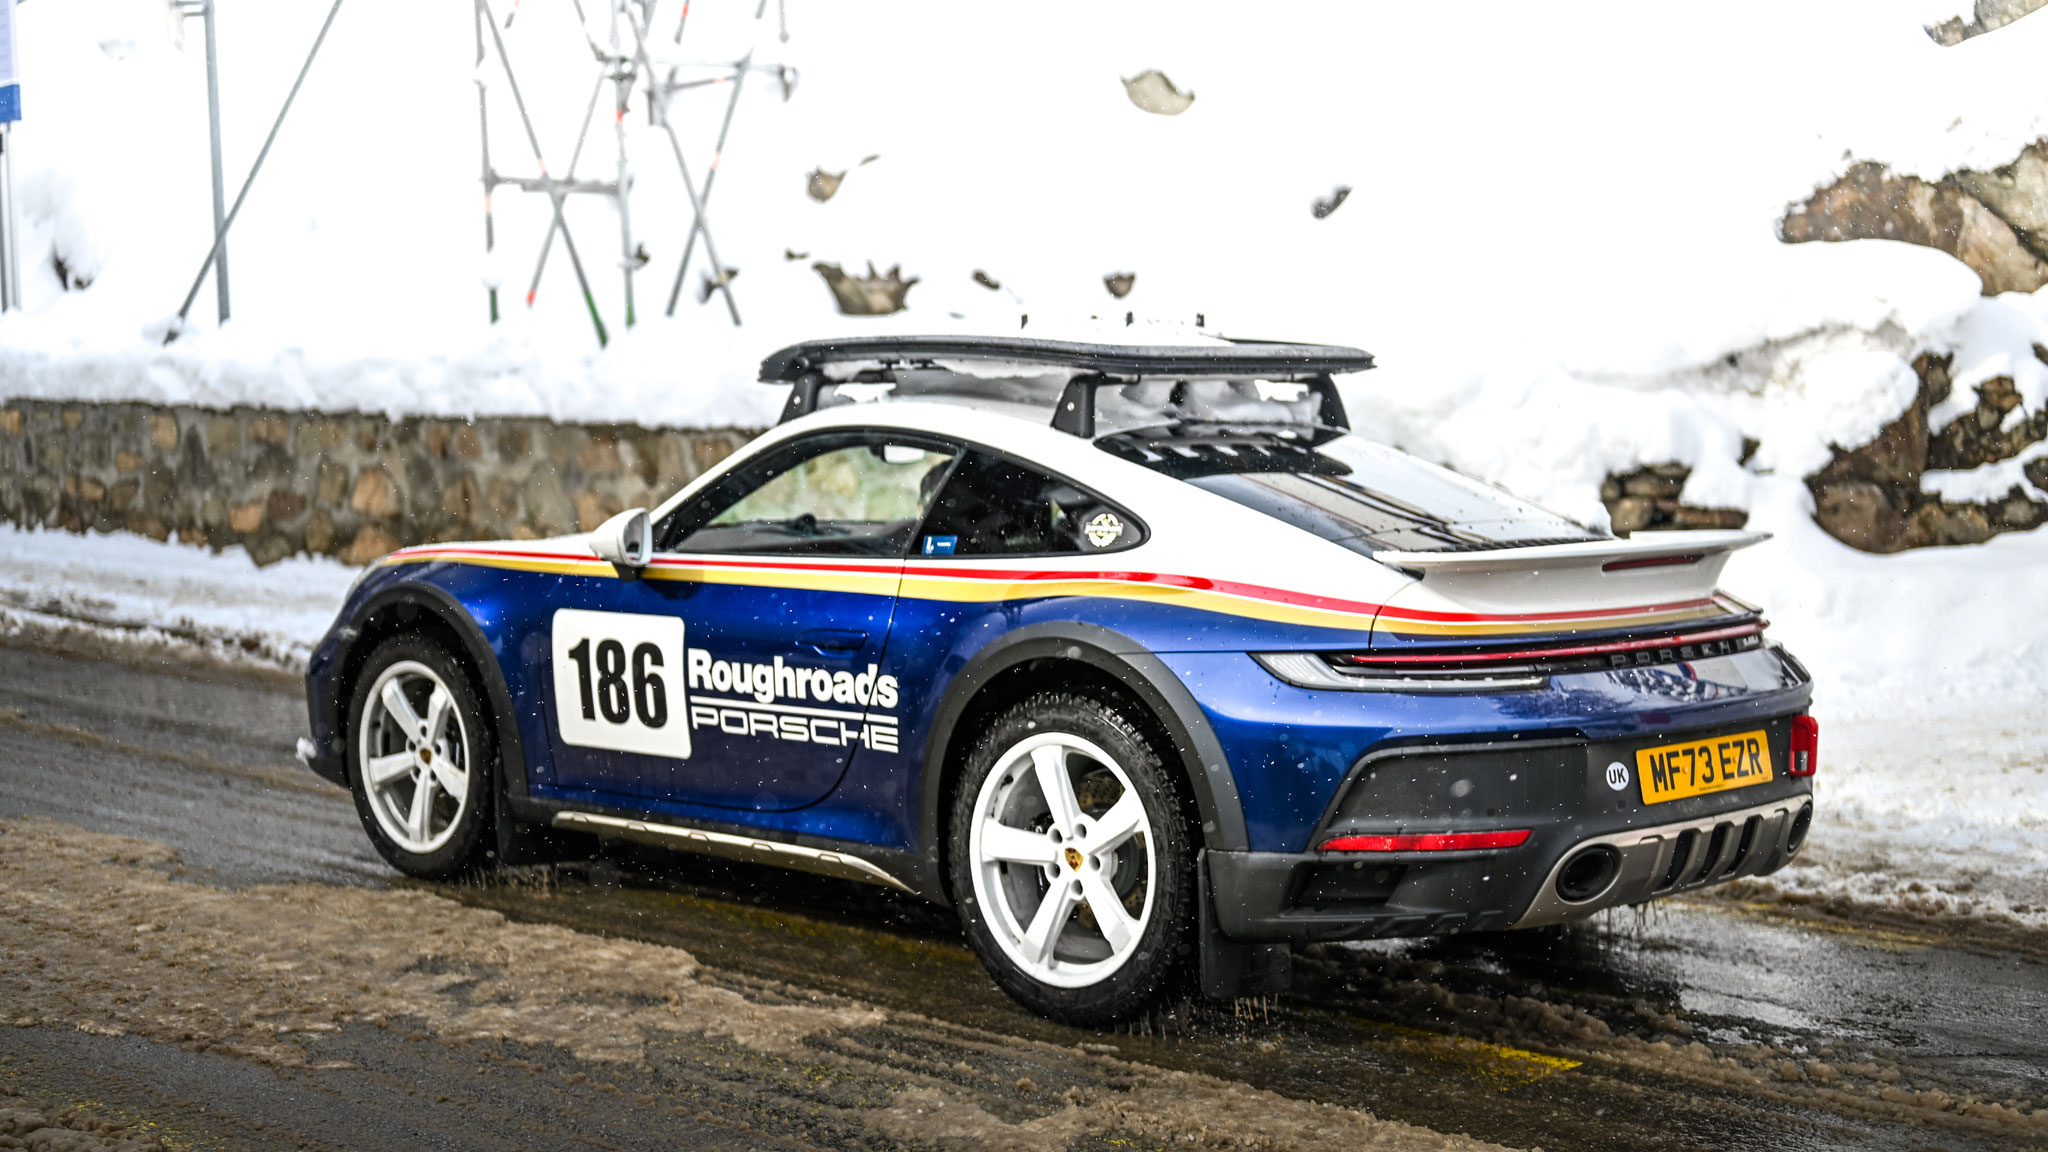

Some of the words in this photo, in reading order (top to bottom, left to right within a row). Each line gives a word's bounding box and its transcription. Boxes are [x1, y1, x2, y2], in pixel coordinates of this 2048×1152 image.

[568, 637, 668, 728] 186
[688, 647, 899, 709] Roughroads
[691, 705, 899, 754] PORSCHE
[1608, 767, 1627, 784] UK
[1649, 746, 1715, 793] MF73
[1718, 738, 1764, 780] EZR
